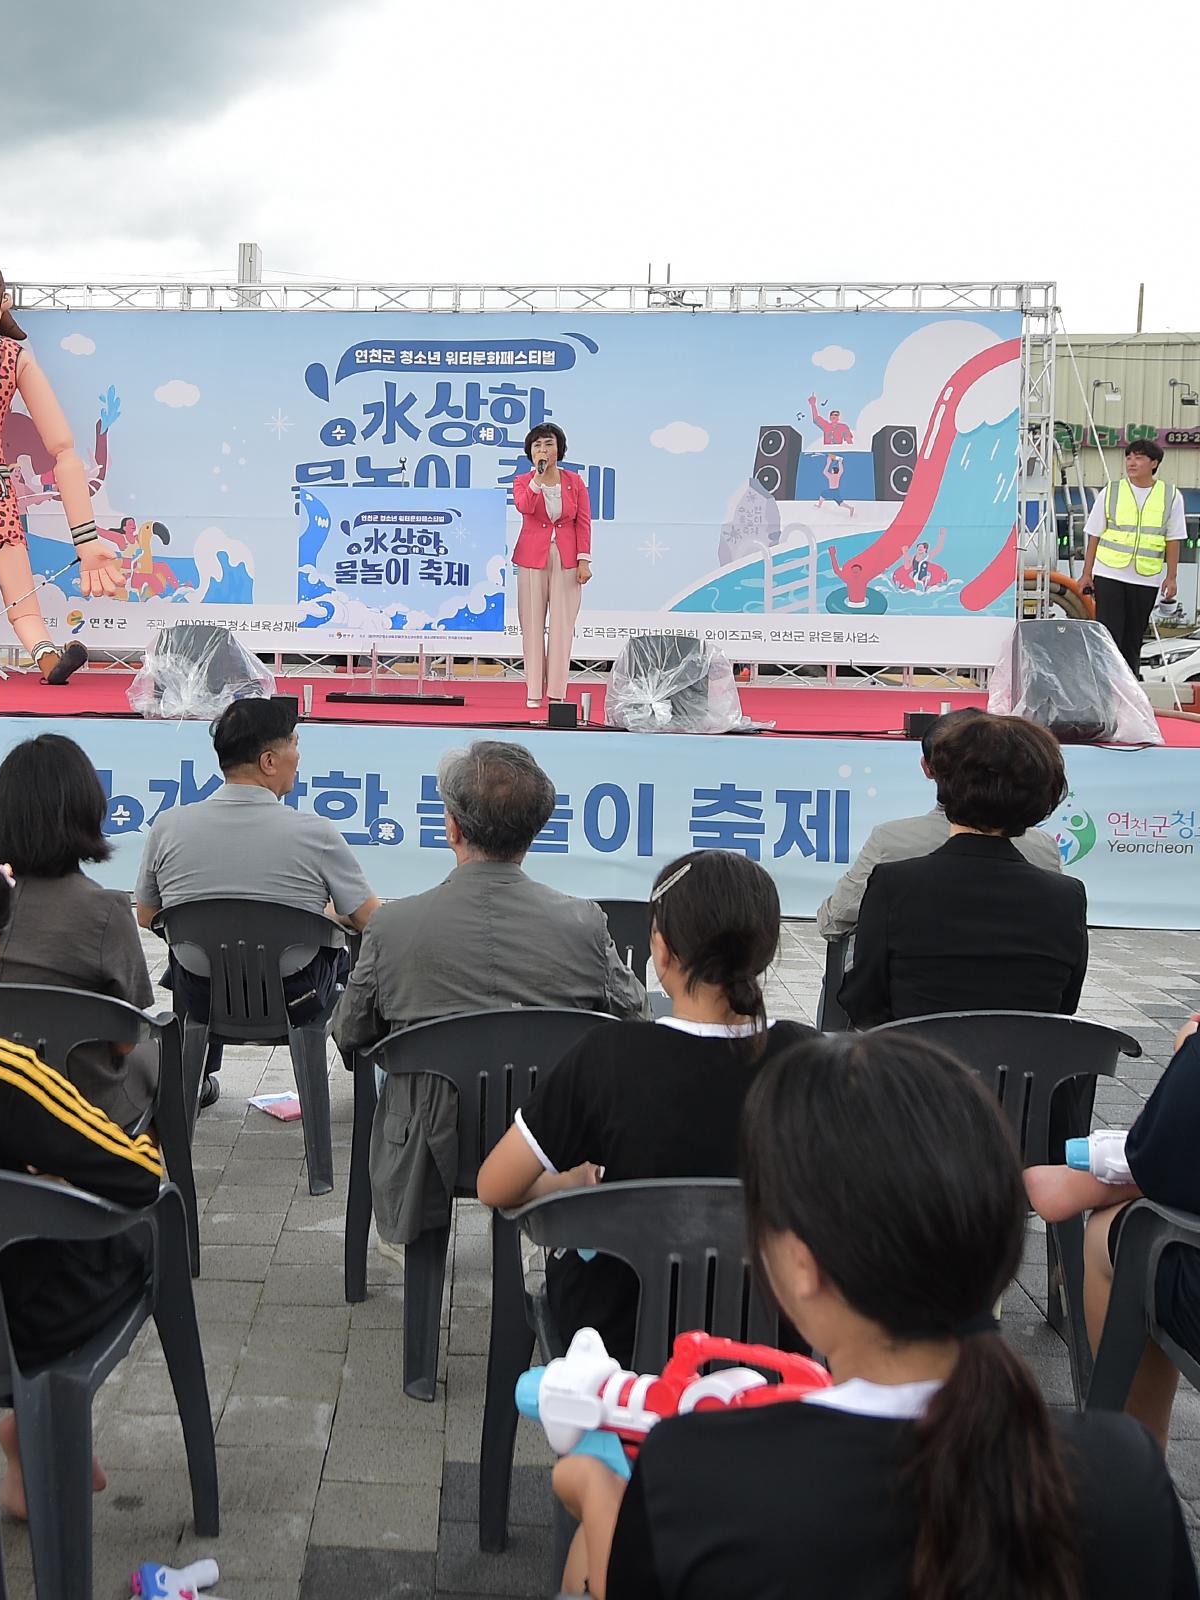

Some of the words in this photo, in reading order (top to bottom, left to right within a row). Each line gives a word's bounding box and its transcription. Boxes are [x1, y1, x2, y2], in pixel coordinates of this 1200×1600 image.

[355, 350, 396, 364] 연천군
[399, 350, 441, 366] 청소년
[445, 350, 556, 366] 워터문화페스티벌
[334, 558, 409, 585] 물놀이
[419, 559, 469, 586] 축제
[770, 630, 805, 644] 연천군
[809, 630, 880, 645] 맑은물사업소
[111, 804, 131, 826] 수
[689, 783, 851, 865] 축제
[1107, 839, 1194, 855] Yeoncheon
